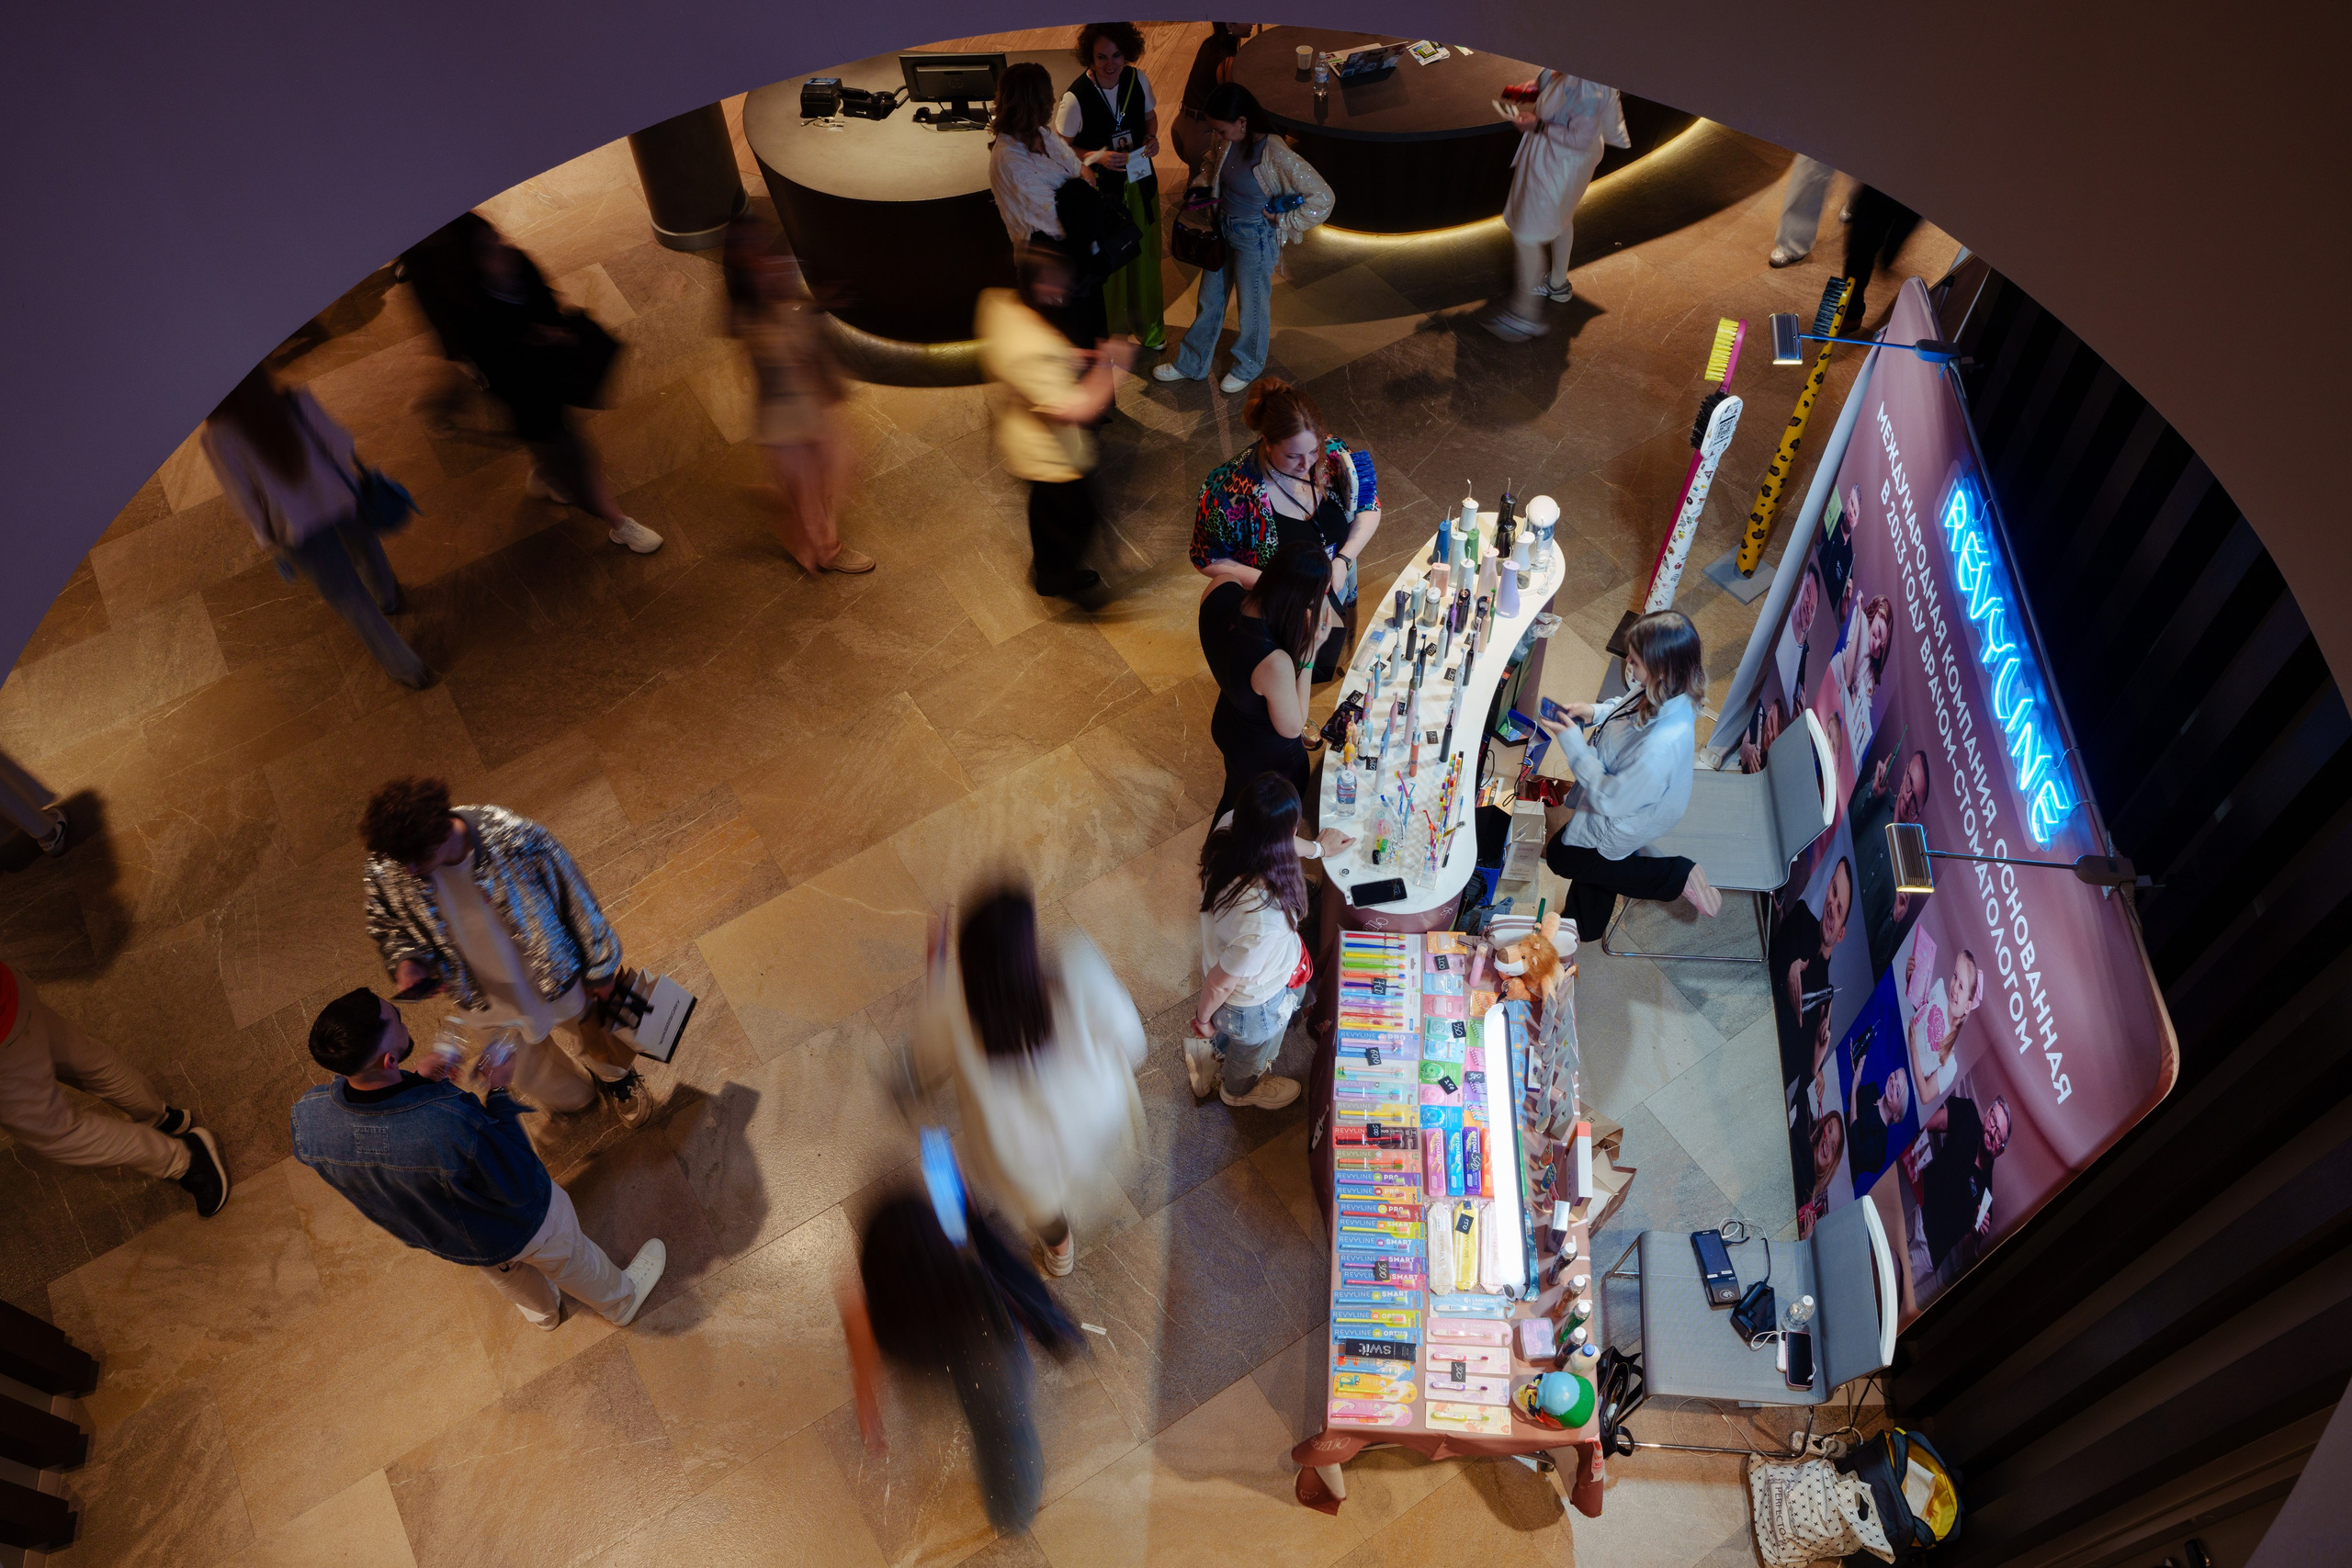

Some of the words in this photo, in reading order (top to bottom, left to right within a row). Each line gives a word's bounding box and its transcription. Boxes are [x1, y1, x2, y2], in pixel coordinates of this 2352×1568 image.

[1877, 401, 1947, 649] МЕЖДУНАРОДНАЯ
[1941, 643, 1996, 839] КОМПАНИЯ,
[1994, 838, 2073, 1105] ОСНОВАННАЯ
[1881, 479, 1890, 505] В
[1886, 501, 1906, 565] 2013
[1902, 560, 1925, 634] ГОДУ
[1919, 635, 2033, 1055] ВРАЧОМ-СТОМАТОЛОГОМ
[1945, 490, 2070, 843] REVYLINE
[1371, 1049, 1381, 1065] 600
[1774, 1486, 1787, 1536] PERFECTO
